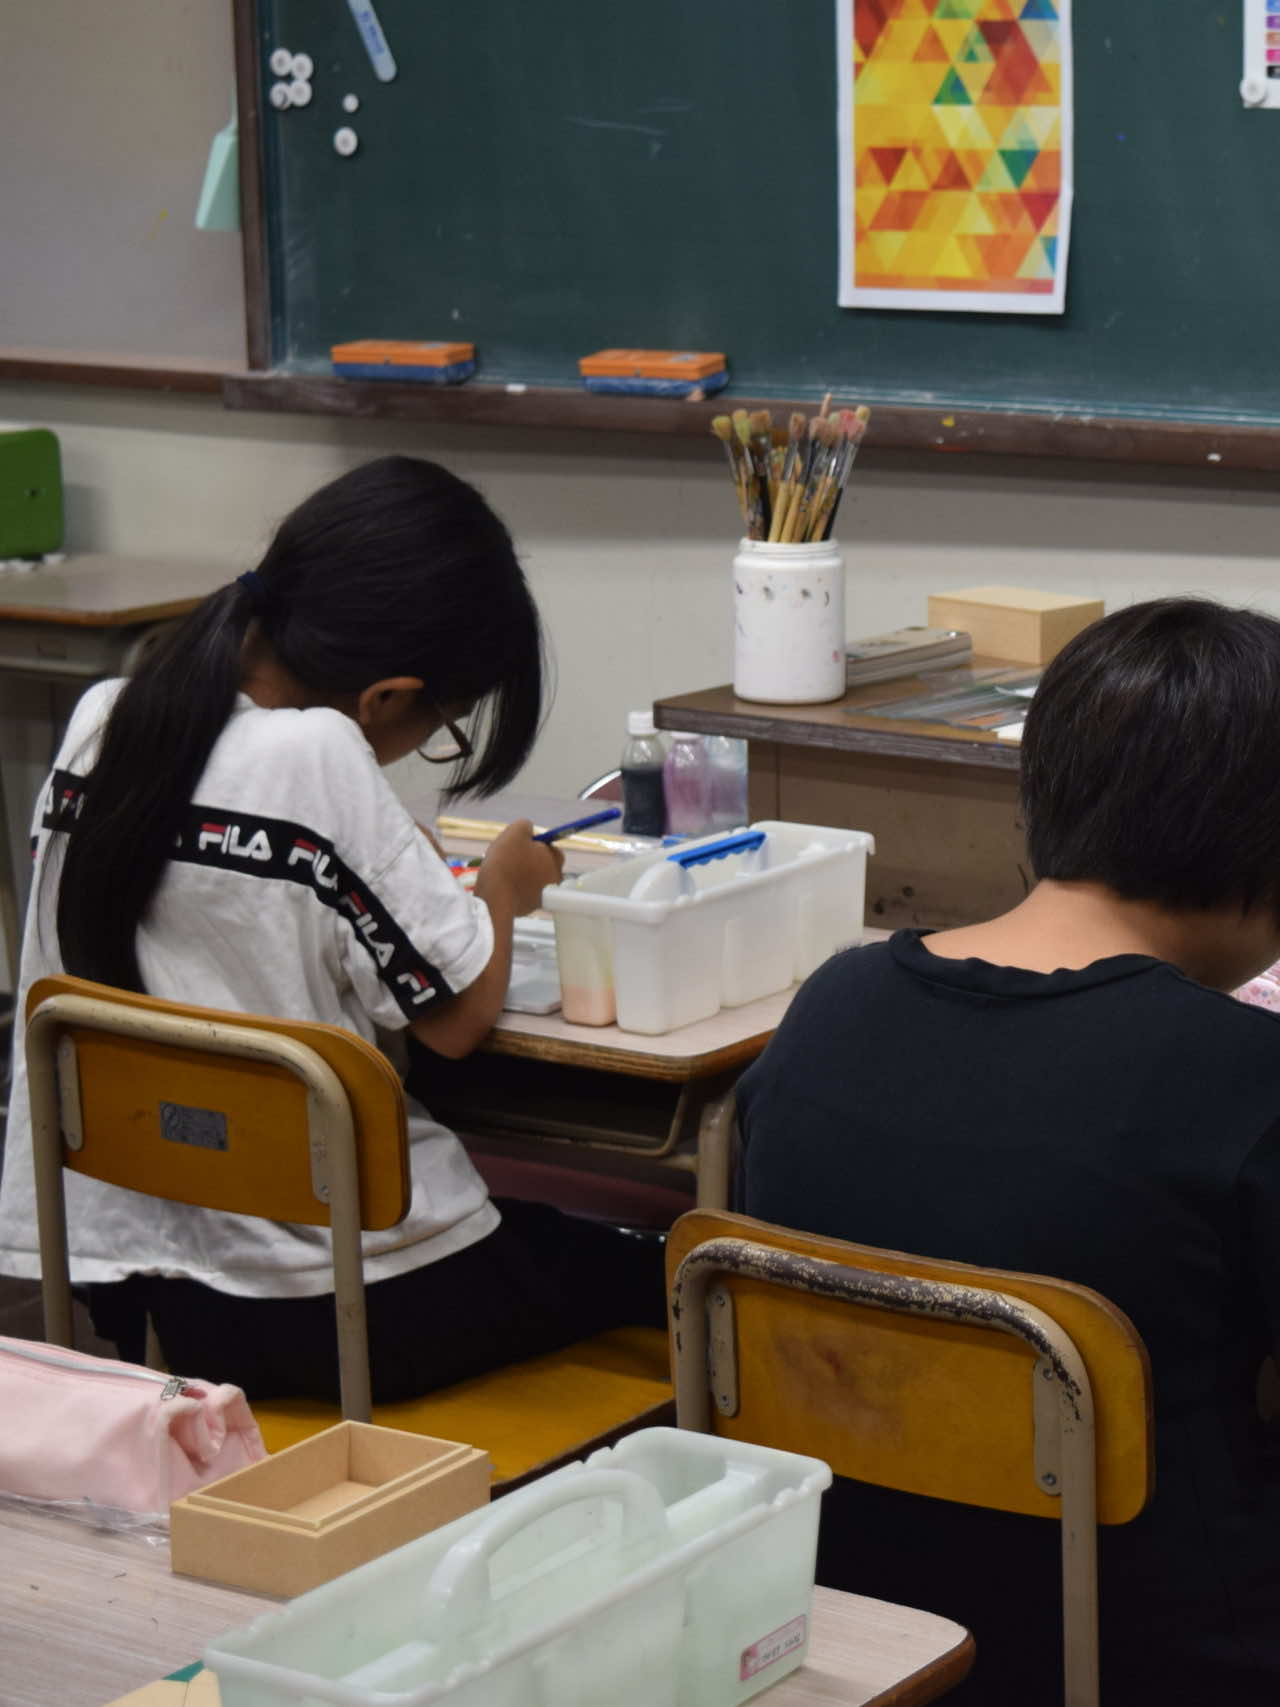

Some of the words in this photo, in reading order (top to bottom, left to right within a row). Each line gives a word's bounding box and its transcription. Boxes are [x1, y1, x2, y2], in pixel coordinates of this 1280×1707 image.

[199, 823, 273, 862] FILA
[287, 838, 338, 891] FIL
[340, 891, 396, 968] FILA
[397, 970, 437, 1005] FI
